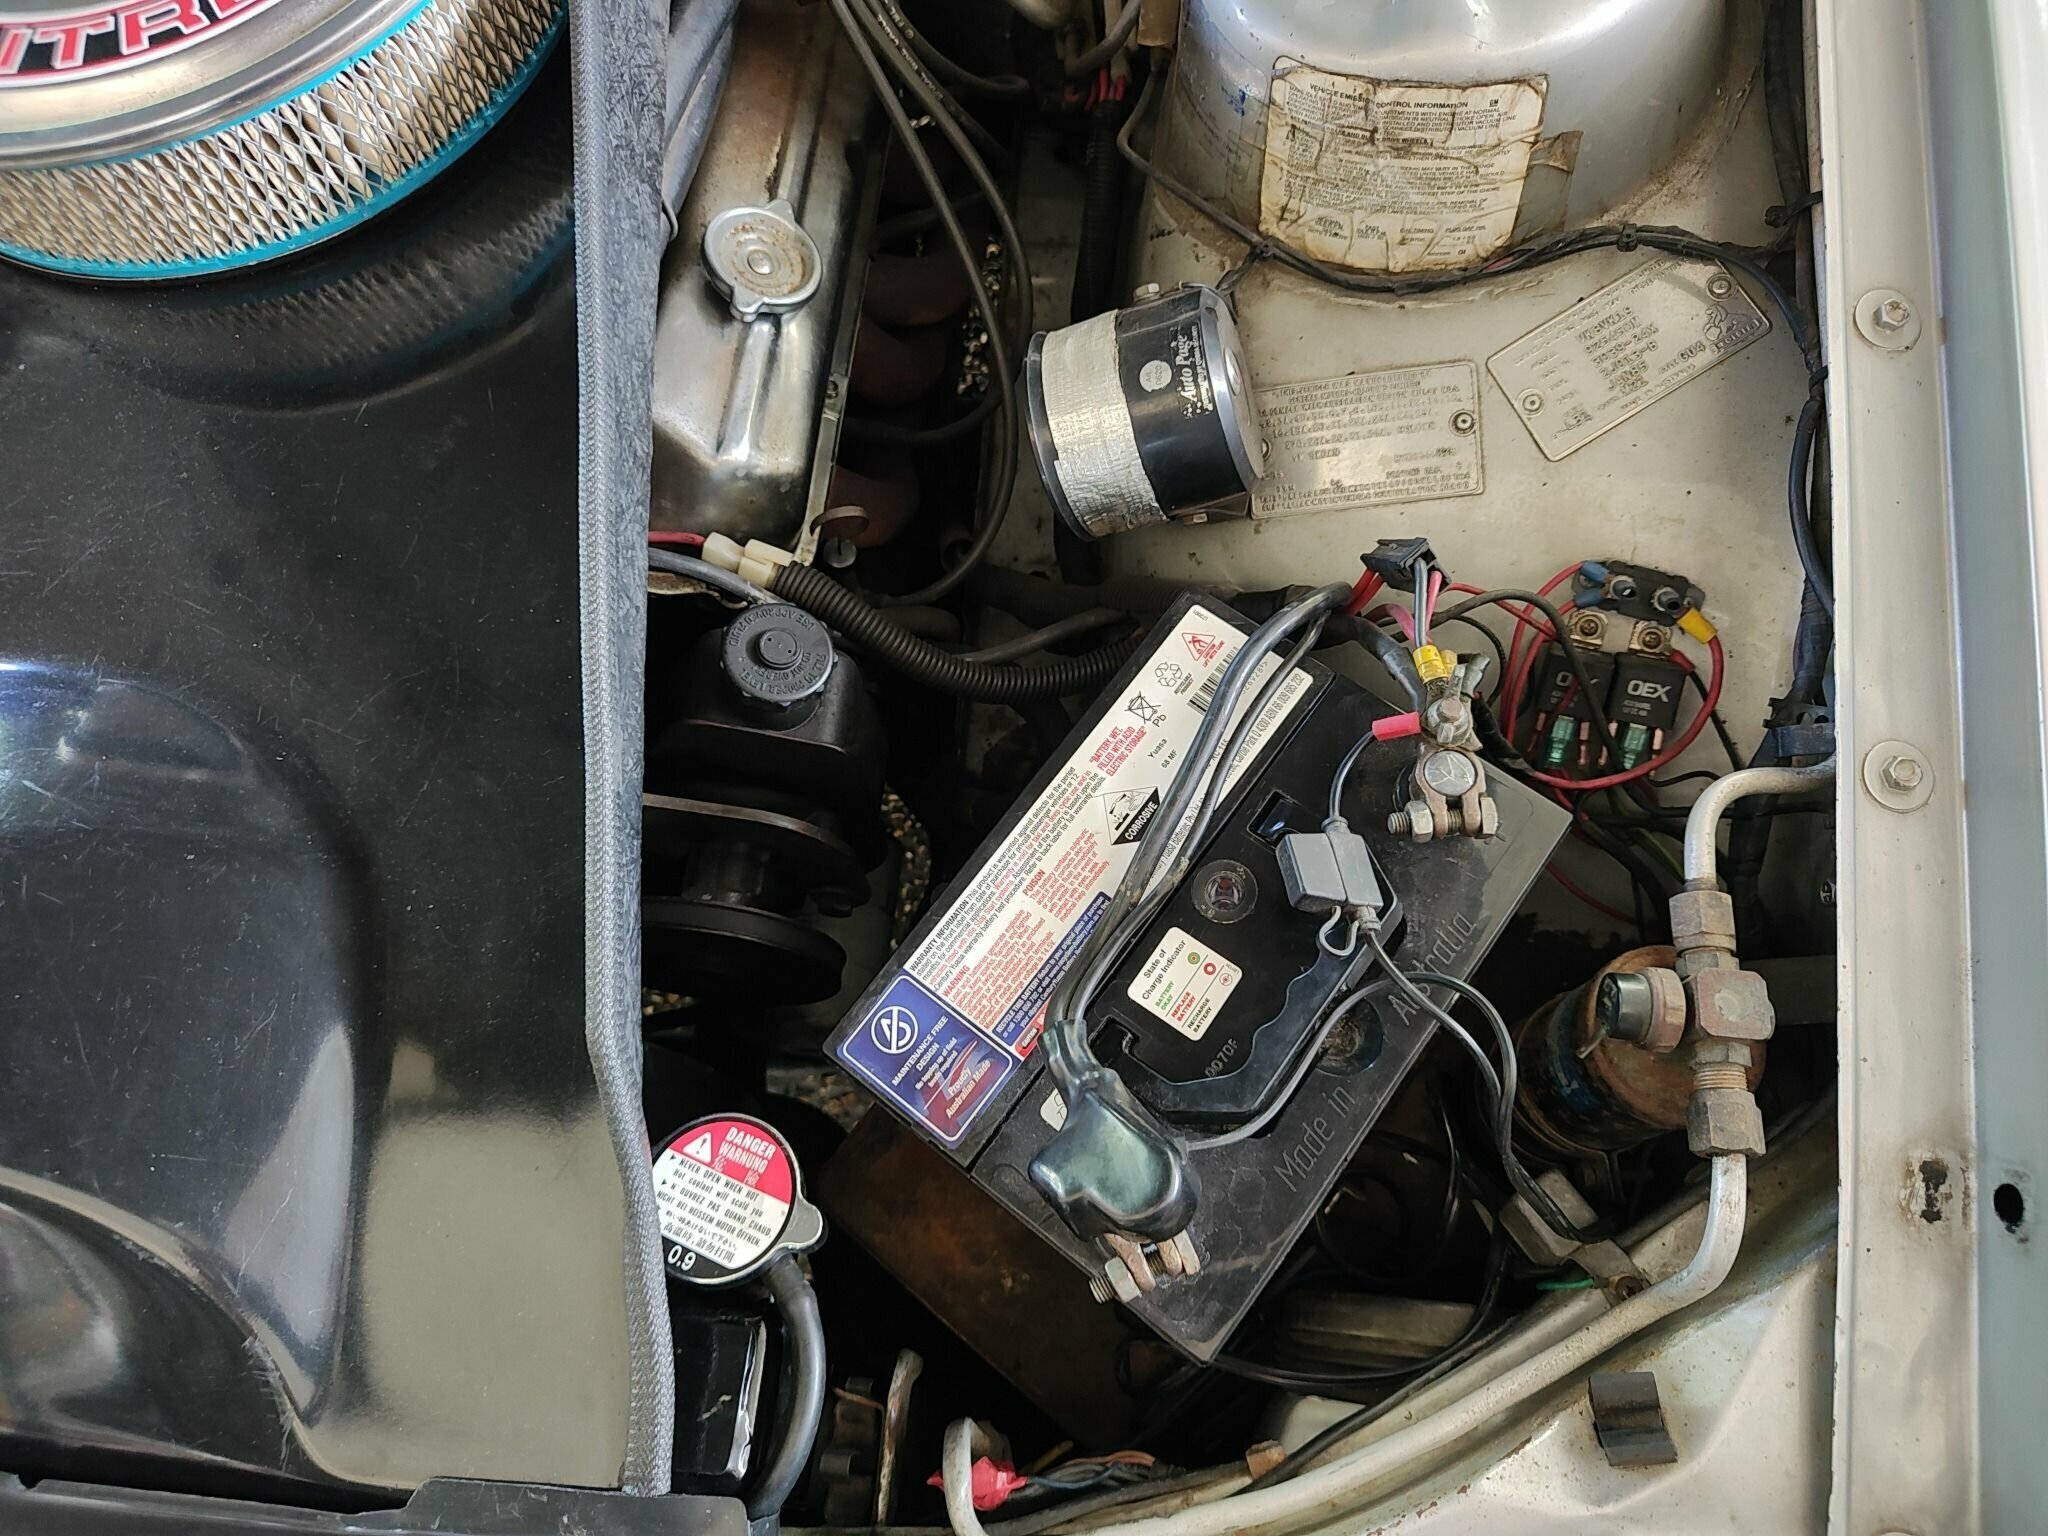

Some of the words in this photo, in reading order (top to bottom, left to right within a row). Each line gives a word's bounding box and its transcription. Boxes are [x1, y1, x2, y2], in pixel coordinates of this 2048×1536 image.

[1310, 83, 1339, 97] VEHICLE
[1627, 680, 1672, 702] OEX
[1152, 712, 1166, 726] Pb
[1098, 752, 1114, 770] FILLED
[1111, 738, 1125, 753] WITH
[1122, 726, 1134, 740] ACID
[1106, 751, 1127, 775] ELECTRIC
[1148, 737, 1166, 758] Yuasa
[1161, 758, 1170, 768] 68
[1167, 749, 1177, 759] MF
[1125, 800, 1157, 840] CORROSIVE
[910, 938, 937, 971] WARRANTY
[936, 900, 968, 938] INFORMATION
[966, 888, 978, 900] This
[976, 868, 994, 889] product
[1017, 818, 1034, 837] against
[1032, 799, 1048, 818] defects
[1053, 782, 1062, 791] the
[1060, 766, 1075, 783] period
[916, 958, 931, 975] stated
[930, 950, 937, 958] on
[936, 941, 945, 951] the
[943, 928, 955, 941] front
[953, 914, 966, 928] label
[964, 901, 976, 915] from
[975, 889, 986, 901] date
[990, 859, 1011, 884] purchase
[1015, 833, 1032, 852] private
[1030, 808, 1052, 834] passenger
[1050, 786, 1068, 807] vehicles
[1071, 773, 1078, 781] 12
[1022, 869, 1045, 895] POISON
[1142, 972, 1164, 1000] Charge
[1160, 939, 1185, 972] Indicator
[1143, 957, 1160, 978] State
[1157, 948, 1166, 958] of
[942, 965, 969, 996] WARNING
[1155, 980, 1174, 1006] BATTERY
[995, 1009, 1015, 1032] RECYCLE
[1012, 998, 1024, 1010] THIS
[1021, 977, 1040, 999] BATTERY
[1160, 994, 1173, 1010] OKAY
[1171, 991, 1190, 1017] REPLACE
[1177, 995, 1195, 1021] BATTERY
[1187, 997, 1209, 1029] RECHARGE
[1193, 1006, 1212, 1032] BATTERY
[891, 1034, 933, 1085] MAINTENANCE
[931, 1015, 947, 1034] FREE
[916, 1043, 939, 1070] DESIGN
[944, 1080, 976, 1117] Australian
[972, 1059, 991, 1080] Made
[947, 1067, 972, 1095] Proudly
[725, 1126, 777, 1160] DANGER
[1272, 1114, 1335, 1188] Made
[1322, 1083, 1354, 1114] in
[719, 1142, 768, 1173] WARNUNG
[673, 1169, 685, 1179] Hot
[688, 1175, 714, 1194] coolant
[716, 1187, 729, 1201] will
[731, 1197, 749, 1211] scald
[751, 1207, 763, 1218] you
[679, 1159, 701, 1174] NEVER
[703, 1170, 720, 1184] OPEN
[724, 1179, 742, 1194] WHEN
[745, 1188, 760, 1202] HOT
[657, 1190, 675, 1204] NICHT
[676, 1201, 688, 1212] BEI
[688, 1204, 715, 1223] HEISSEM
[715, 1218, 736, 1234] MOTOR
[680, 1187, 705, 1204] OUVREZ
[708, 1200, 720, 1213] PAS
[724, 1208, 747, 1225] QUAND
[668, 1245, 696, 1271] 0.9
